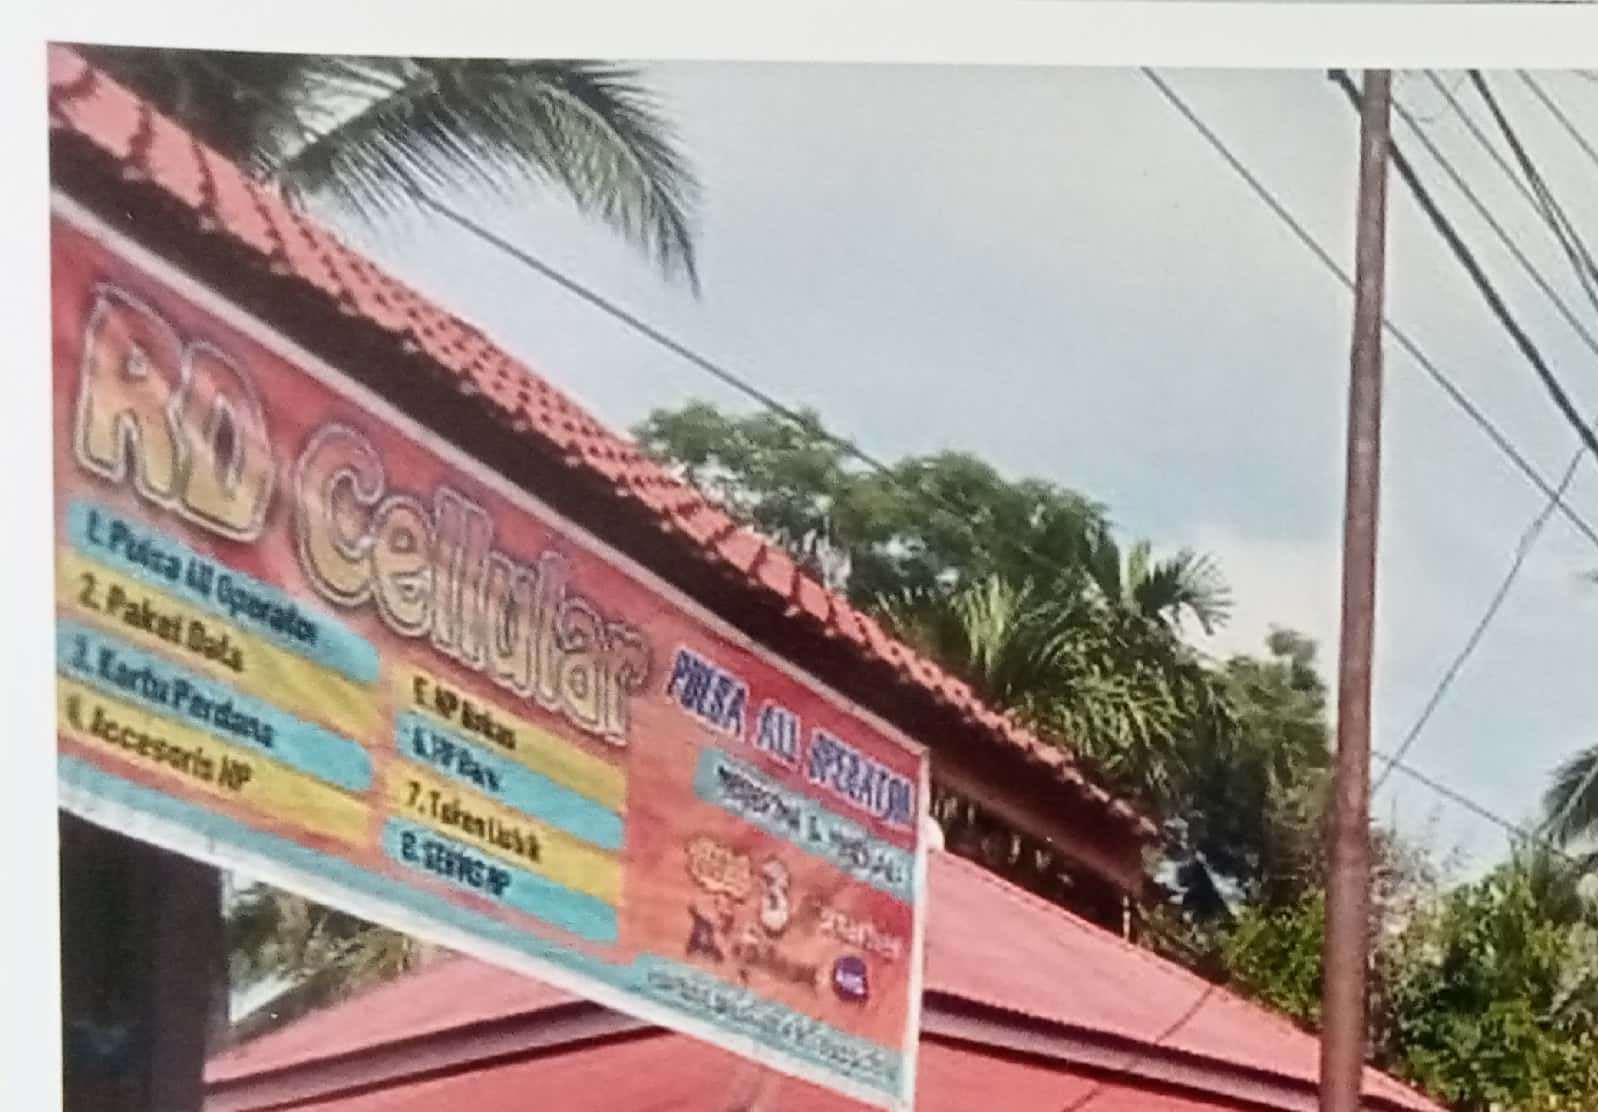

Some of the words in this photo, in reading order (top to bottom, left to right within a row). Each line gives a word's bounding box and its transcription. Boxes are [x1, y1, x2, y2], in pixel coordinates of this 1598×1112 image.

[74, 281, 275, 542] RD
[294, 423, 652, 747] Cellular
[666, 648, 747, 739] PULSA
